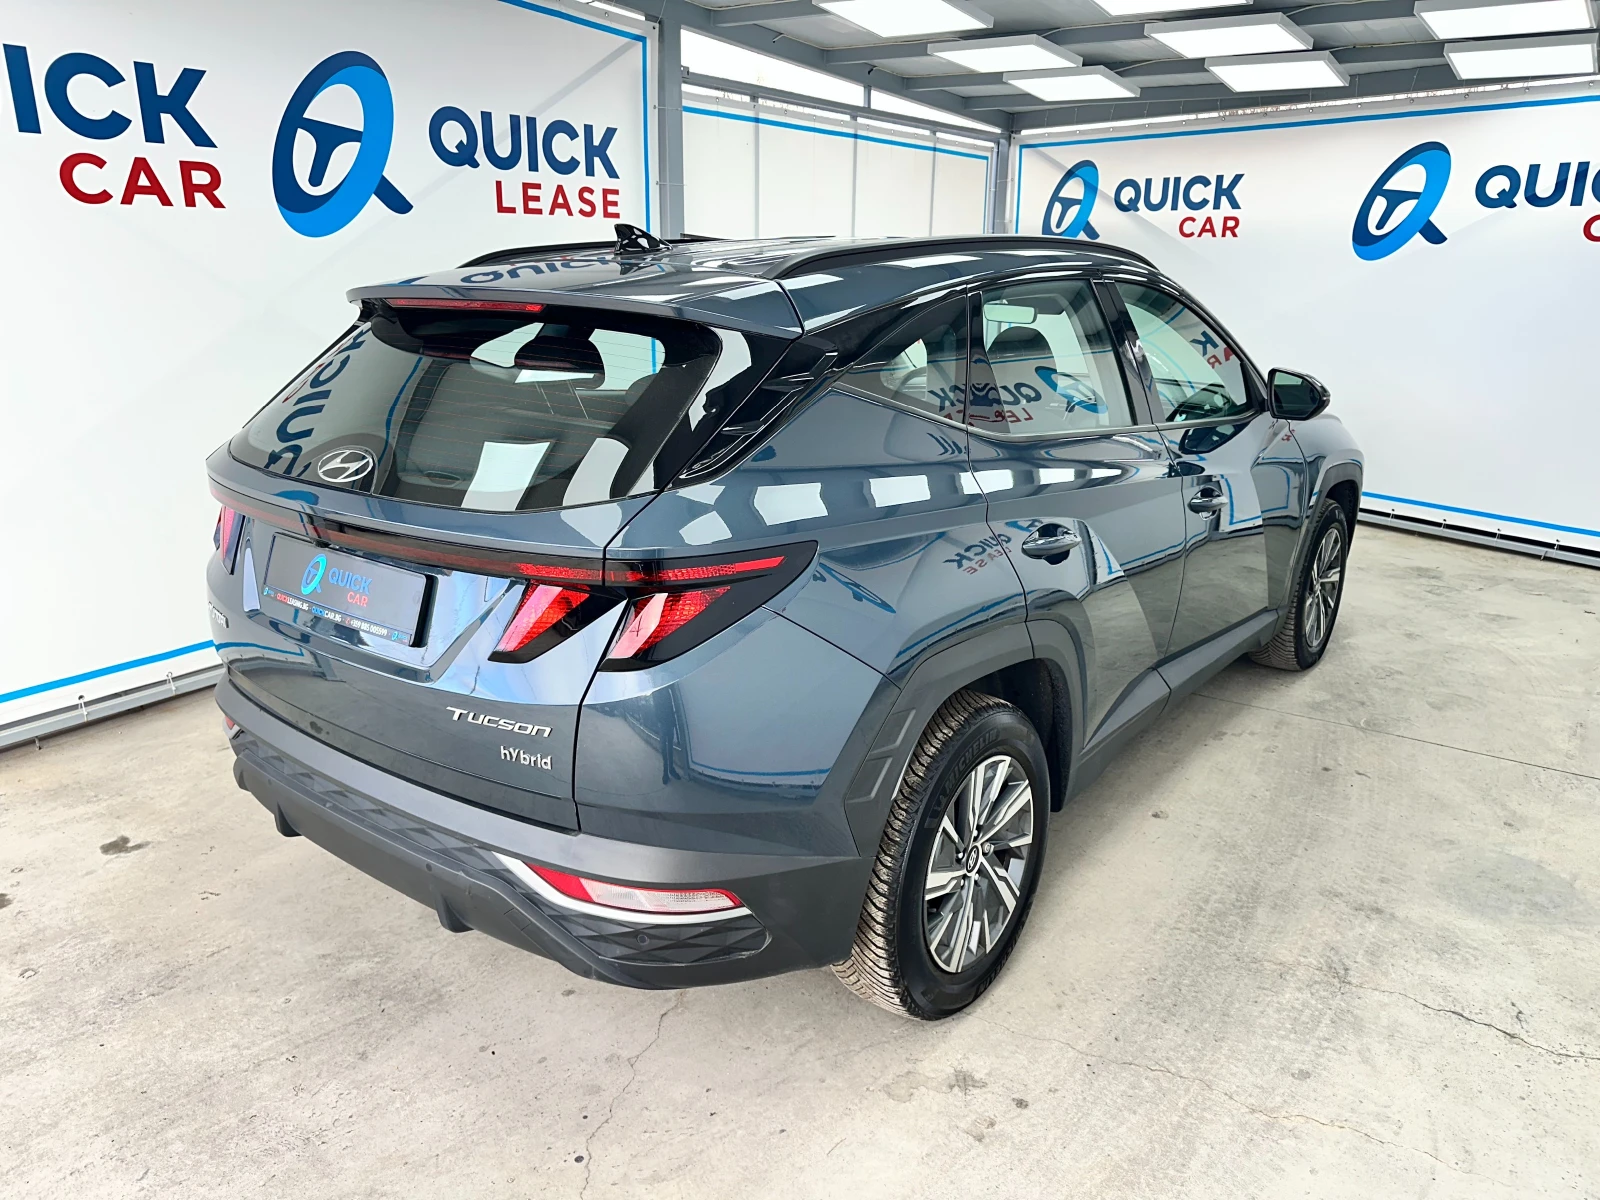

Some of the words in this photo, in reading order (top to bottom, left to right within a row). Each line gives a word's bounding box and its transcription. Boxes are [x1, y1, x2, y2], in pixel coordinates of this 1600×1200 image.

[428, 106, 620, 179] QUICK
[59, 152, 226, 209] CAR
[495, 180, 621, 219] LEASE
[1113, 173, 1245, 213] QUICK
[1178, 216, 1240, 239] CAR
[328, 567, 372, 595] QUICK
[347, 591, 368, 607] CAR
[944, 727, 1000, 792] MICHELIN
